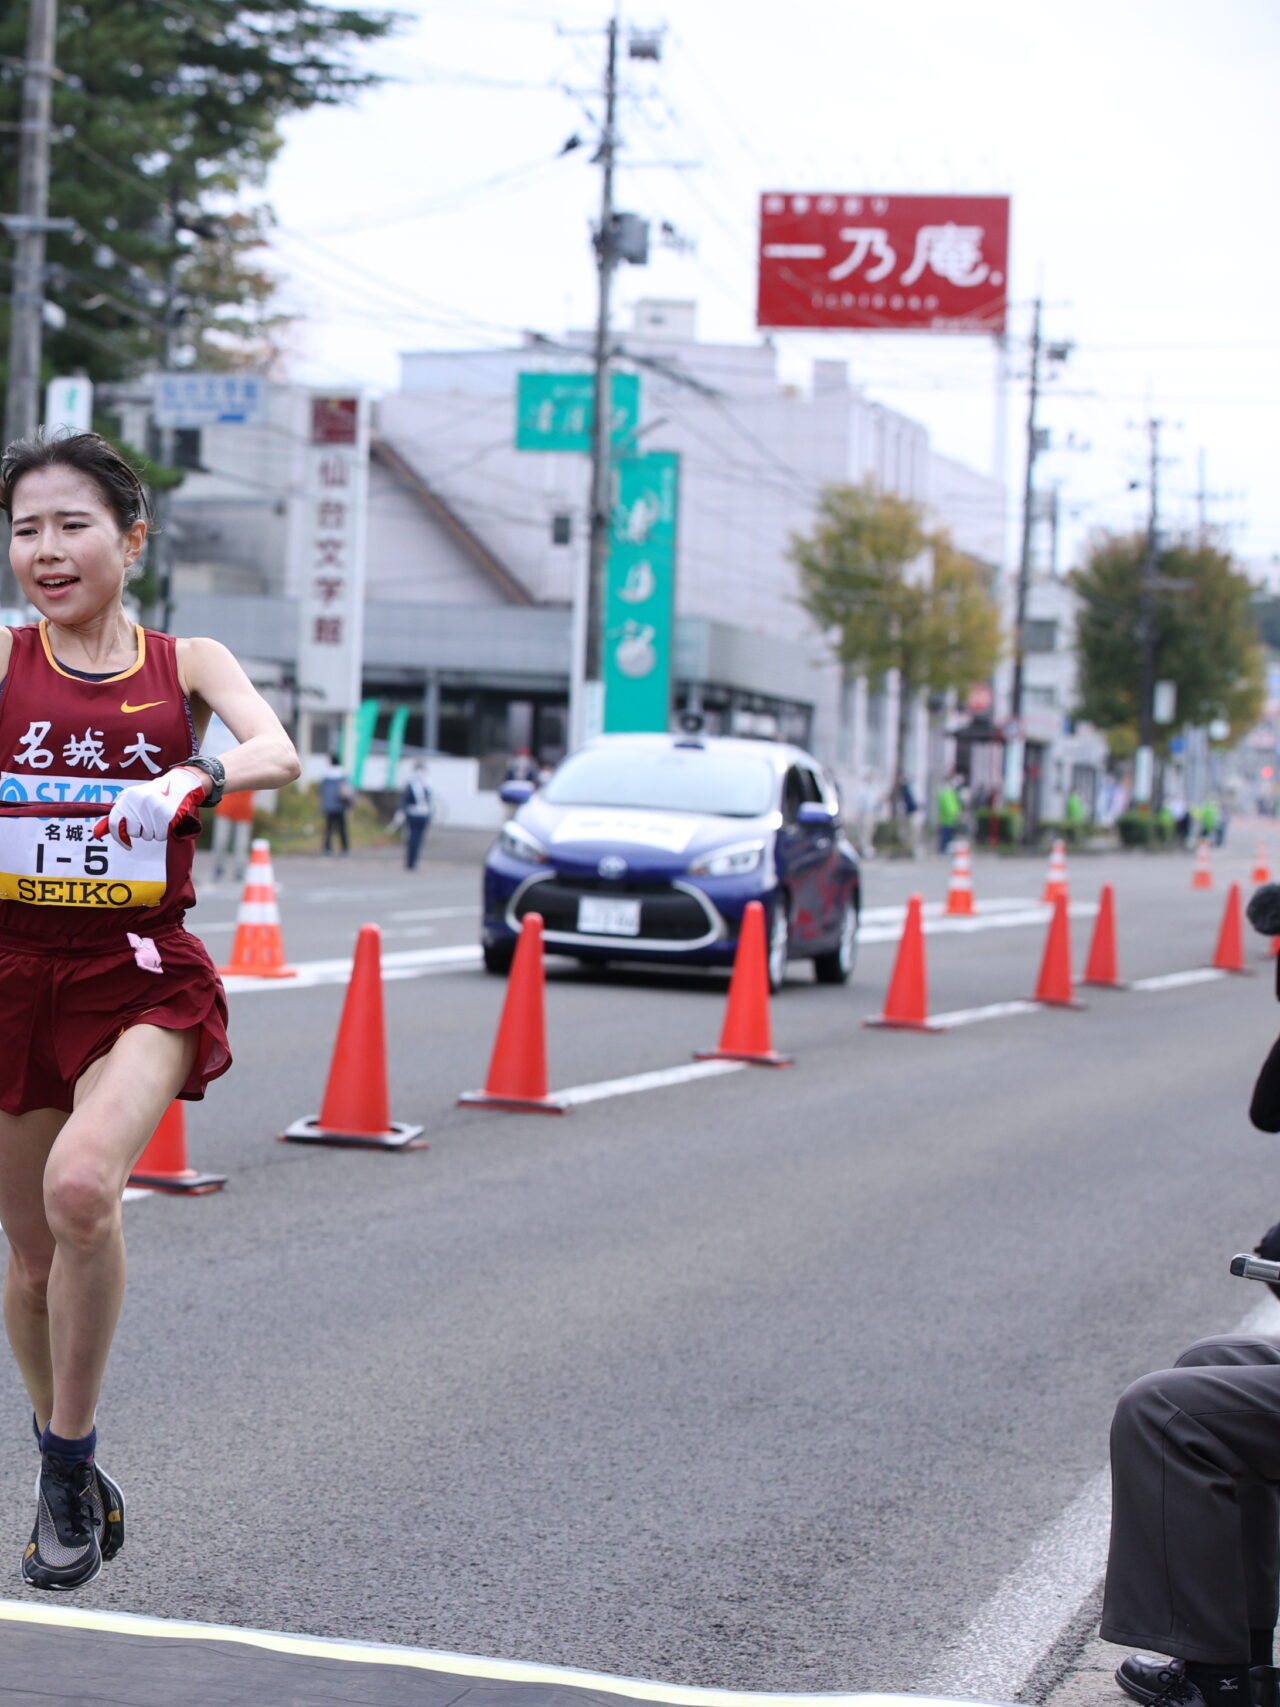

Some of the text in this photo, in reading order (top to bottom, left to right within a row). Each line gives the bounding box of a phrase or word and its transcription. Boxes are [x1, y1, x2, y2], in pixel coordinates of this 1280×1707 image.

[13, 721, 162, 774] 名城大
[36, 844, 109, 876] 1-5
[18, 879, 132, 905] SEIKO
